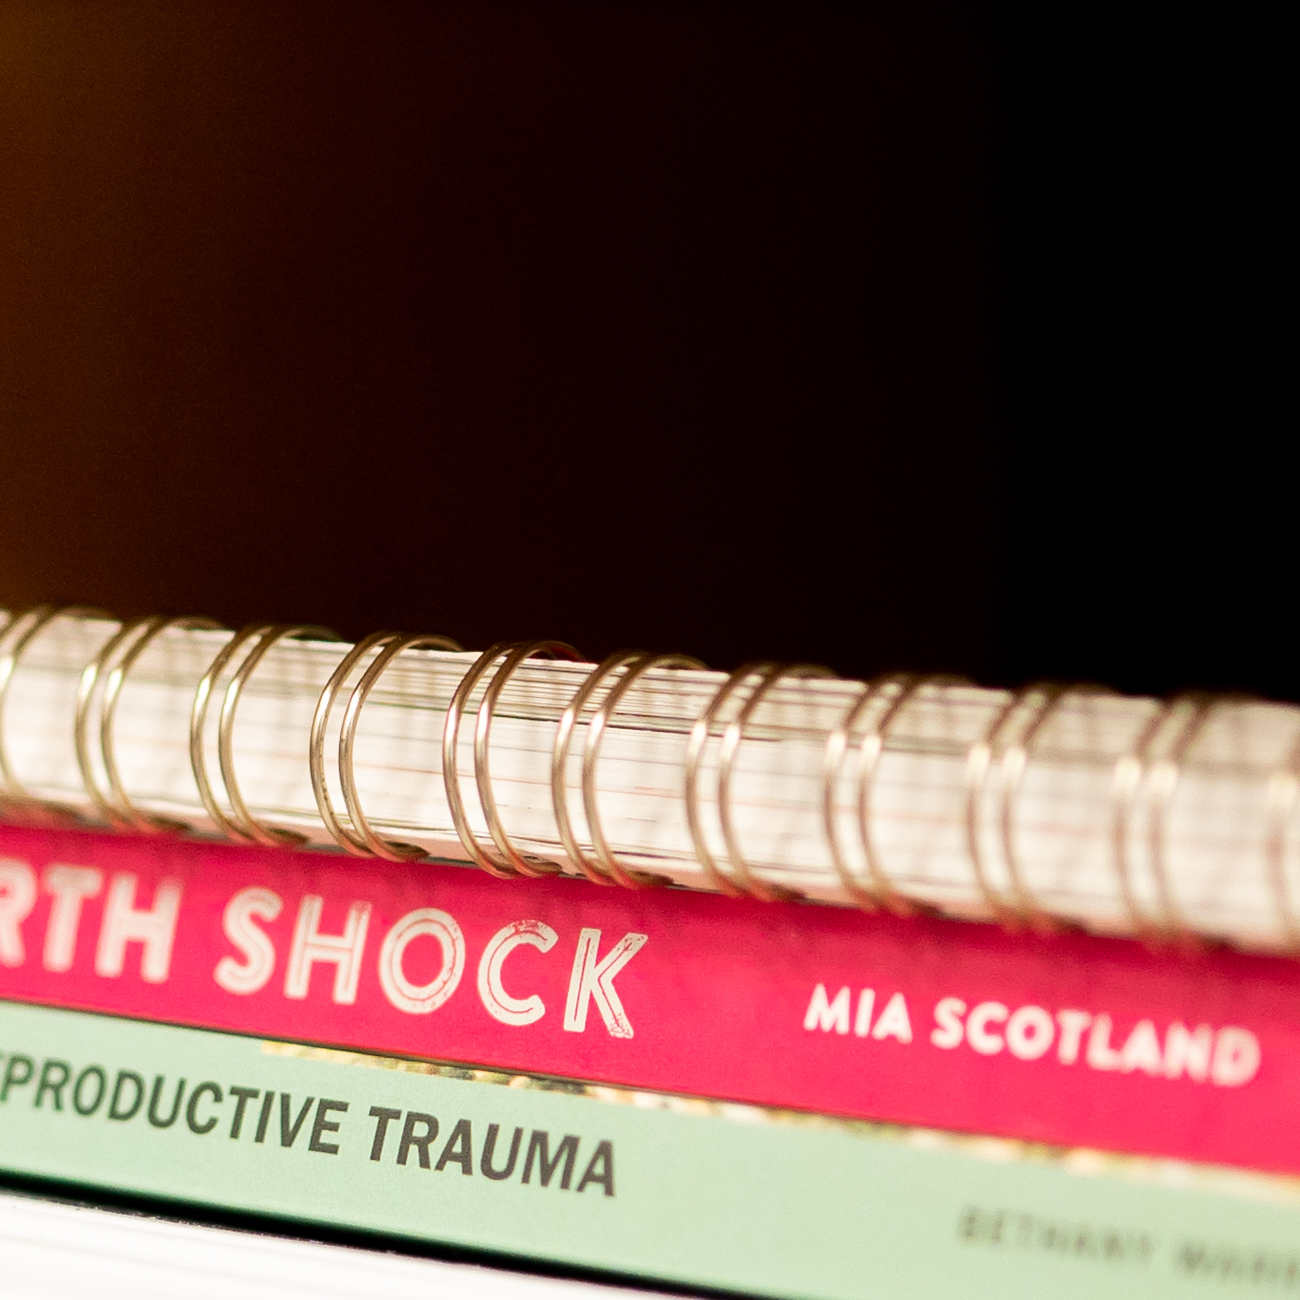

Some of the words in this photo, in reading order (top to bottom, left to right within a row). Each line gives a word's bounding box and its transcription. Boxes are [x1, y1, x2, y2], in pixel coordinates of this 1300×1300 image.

[214, 886, 648, 1039] SHOCK
[804, 982, 913, 1043] MIA
[929, 997, 1261, 1087] SCOTLAND
[366, 1105, 616, 1197] TRAUMA
